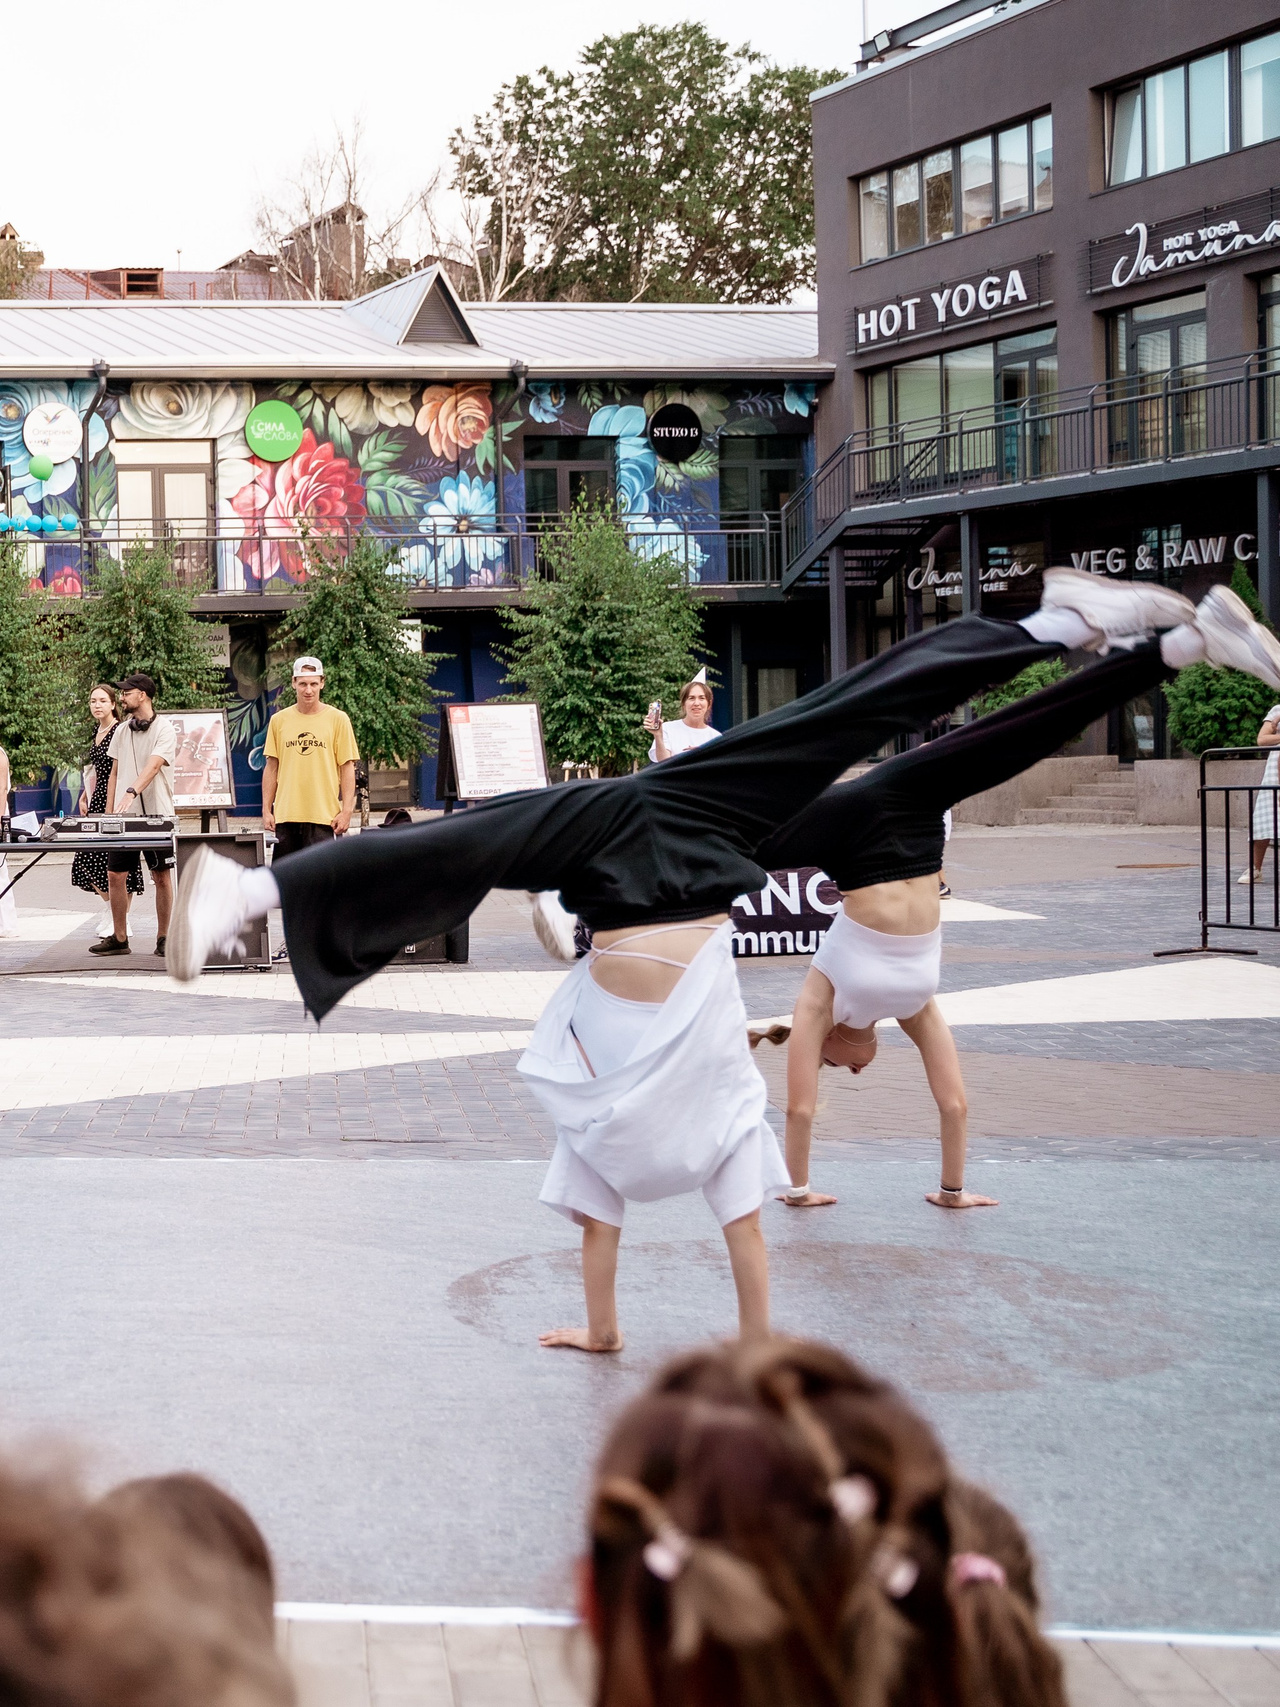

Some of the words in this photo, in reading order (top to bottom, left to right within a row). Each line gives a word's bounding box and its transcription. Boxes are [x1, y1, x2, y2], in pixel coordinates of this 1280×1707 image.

[1163, 232, 1195, 251] HOT
[1197, 220, 1241, 241] YOGA
[858, 297, 921, 343] HOT
[930, 269, 1028, 323] YOGA
[257, 422, 285, 432] СИЛА
[263, 431, 299, 441] СЛОВА
[690, 427, 699, 437] 13
[1070, 548, 1127, 575] VEG
[1135, 544, 1158, 571] &
[1163, 536, 1228, 569] RAW
[1233, 533, 1259, 561] C
[907, 547, 1038, 590] Jamna
[285, 740, 327, 749] UNIVERSAL
